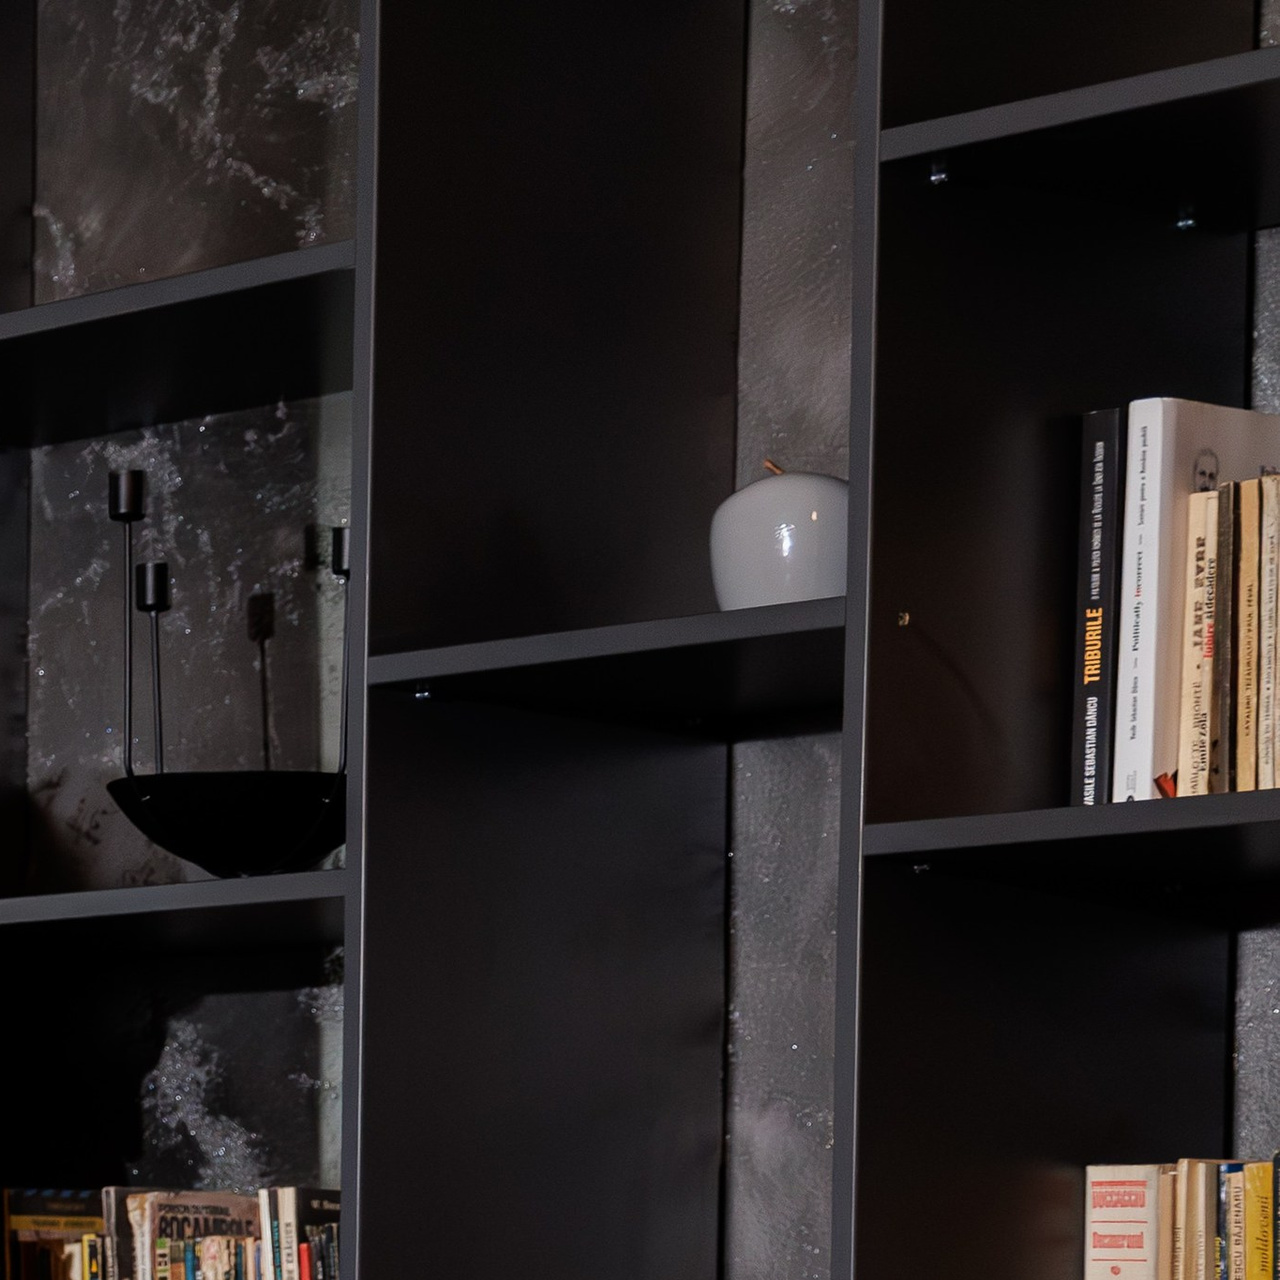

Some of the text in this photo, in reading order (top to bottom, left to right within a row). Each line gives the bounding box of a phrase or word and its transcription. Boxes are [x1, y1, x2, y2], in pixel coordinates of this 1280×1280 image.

[1084, 607, 1103, 685] TRIBURILE
[1193, 601, 1204, 652] JANE
[1084, 728, 1097, 777] SEBASTIAN
